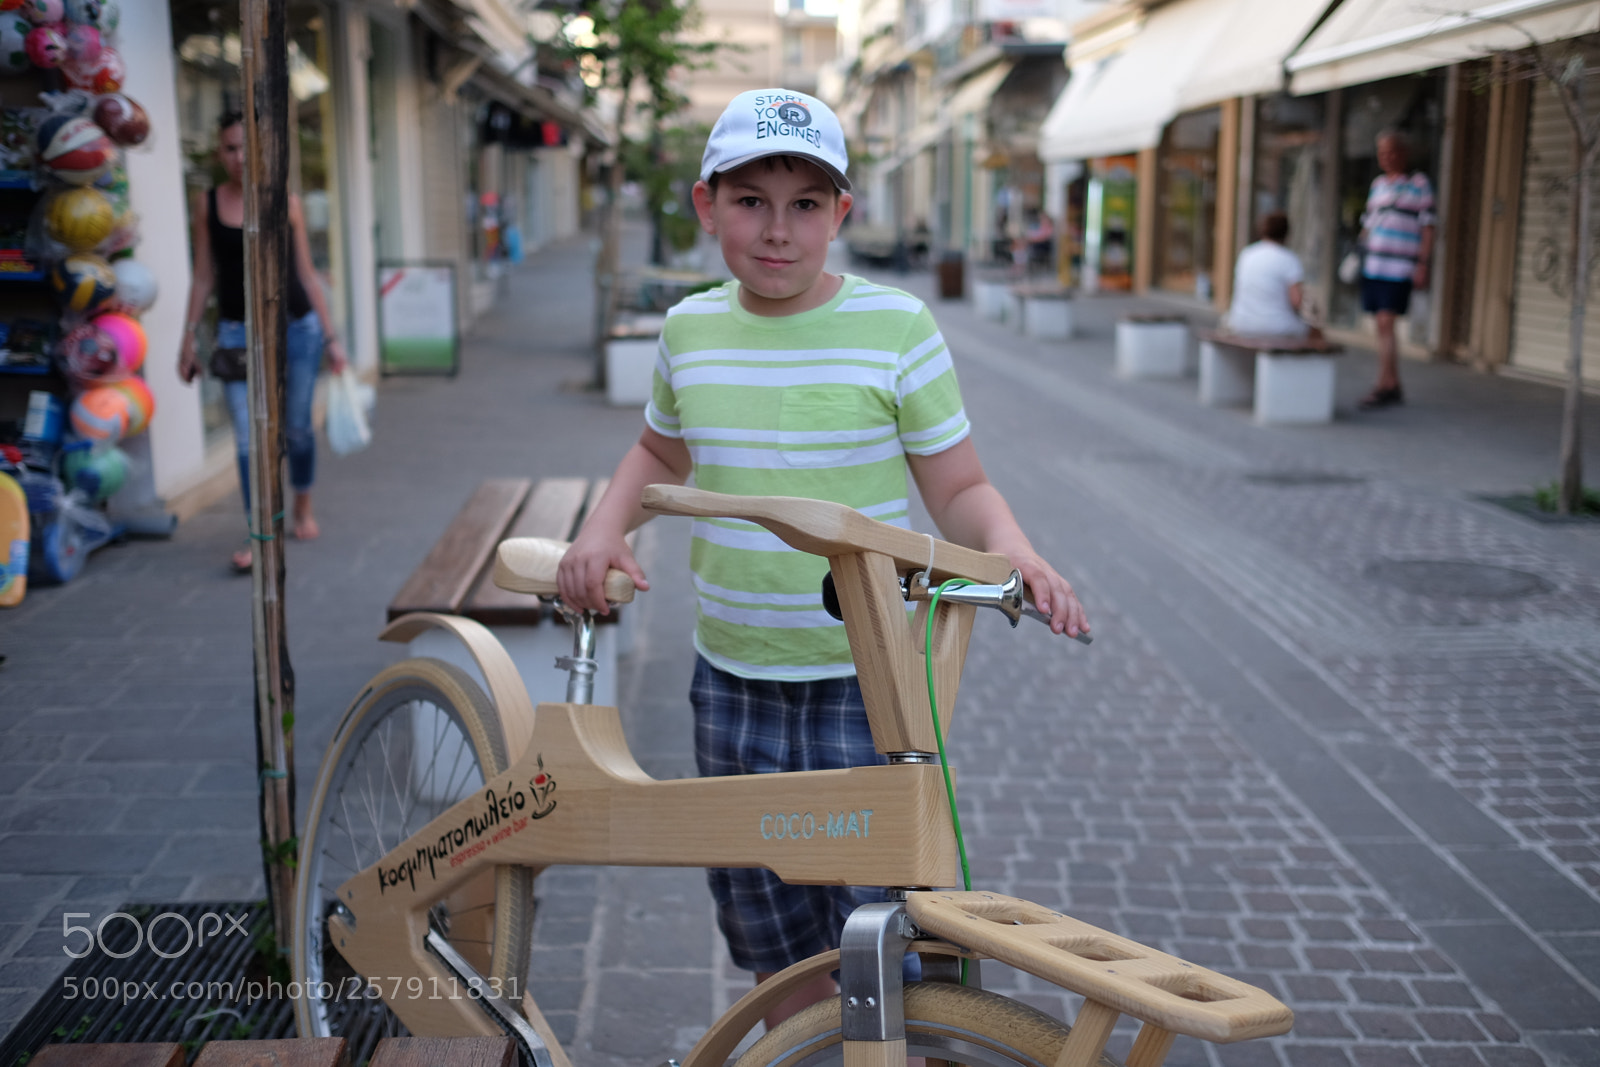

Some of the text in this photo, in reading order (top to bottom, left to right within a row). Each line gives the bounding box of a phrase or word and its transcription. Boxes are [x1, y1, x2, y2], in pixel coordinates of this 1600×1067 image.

[755, 95, 803, 106] START
[754, 107, 800, 122] YOUR
[756, 121, 821, 149] ENGINES
[512, 816, 528, 833] bar
[760, 809, 874, 840] COCO-MAT
